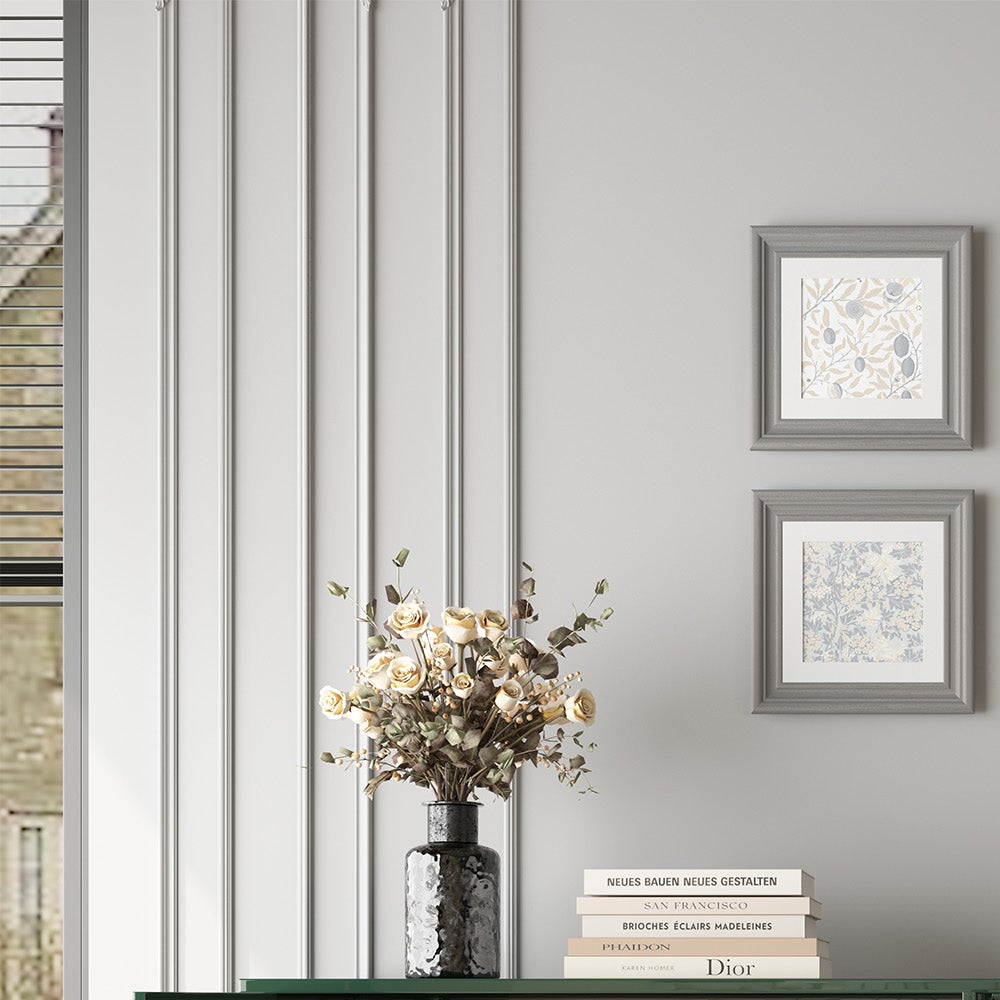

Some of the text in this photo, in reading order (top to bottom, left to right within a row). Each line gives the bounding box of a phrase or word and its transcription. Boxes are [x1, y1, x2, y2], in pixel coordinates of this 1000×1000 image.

[607, 876, 778, 888] NEUES BAUEN NEUES GESTALTEN
[643, 901, 748, 911] SAN FRANCISCO
[622, 920, 773, 931] BRIOCHES ÉCLAIRS MADELEINES
[602, 943, 671, 951] PHAIDON
[707, 958, 756, 977] Dior
